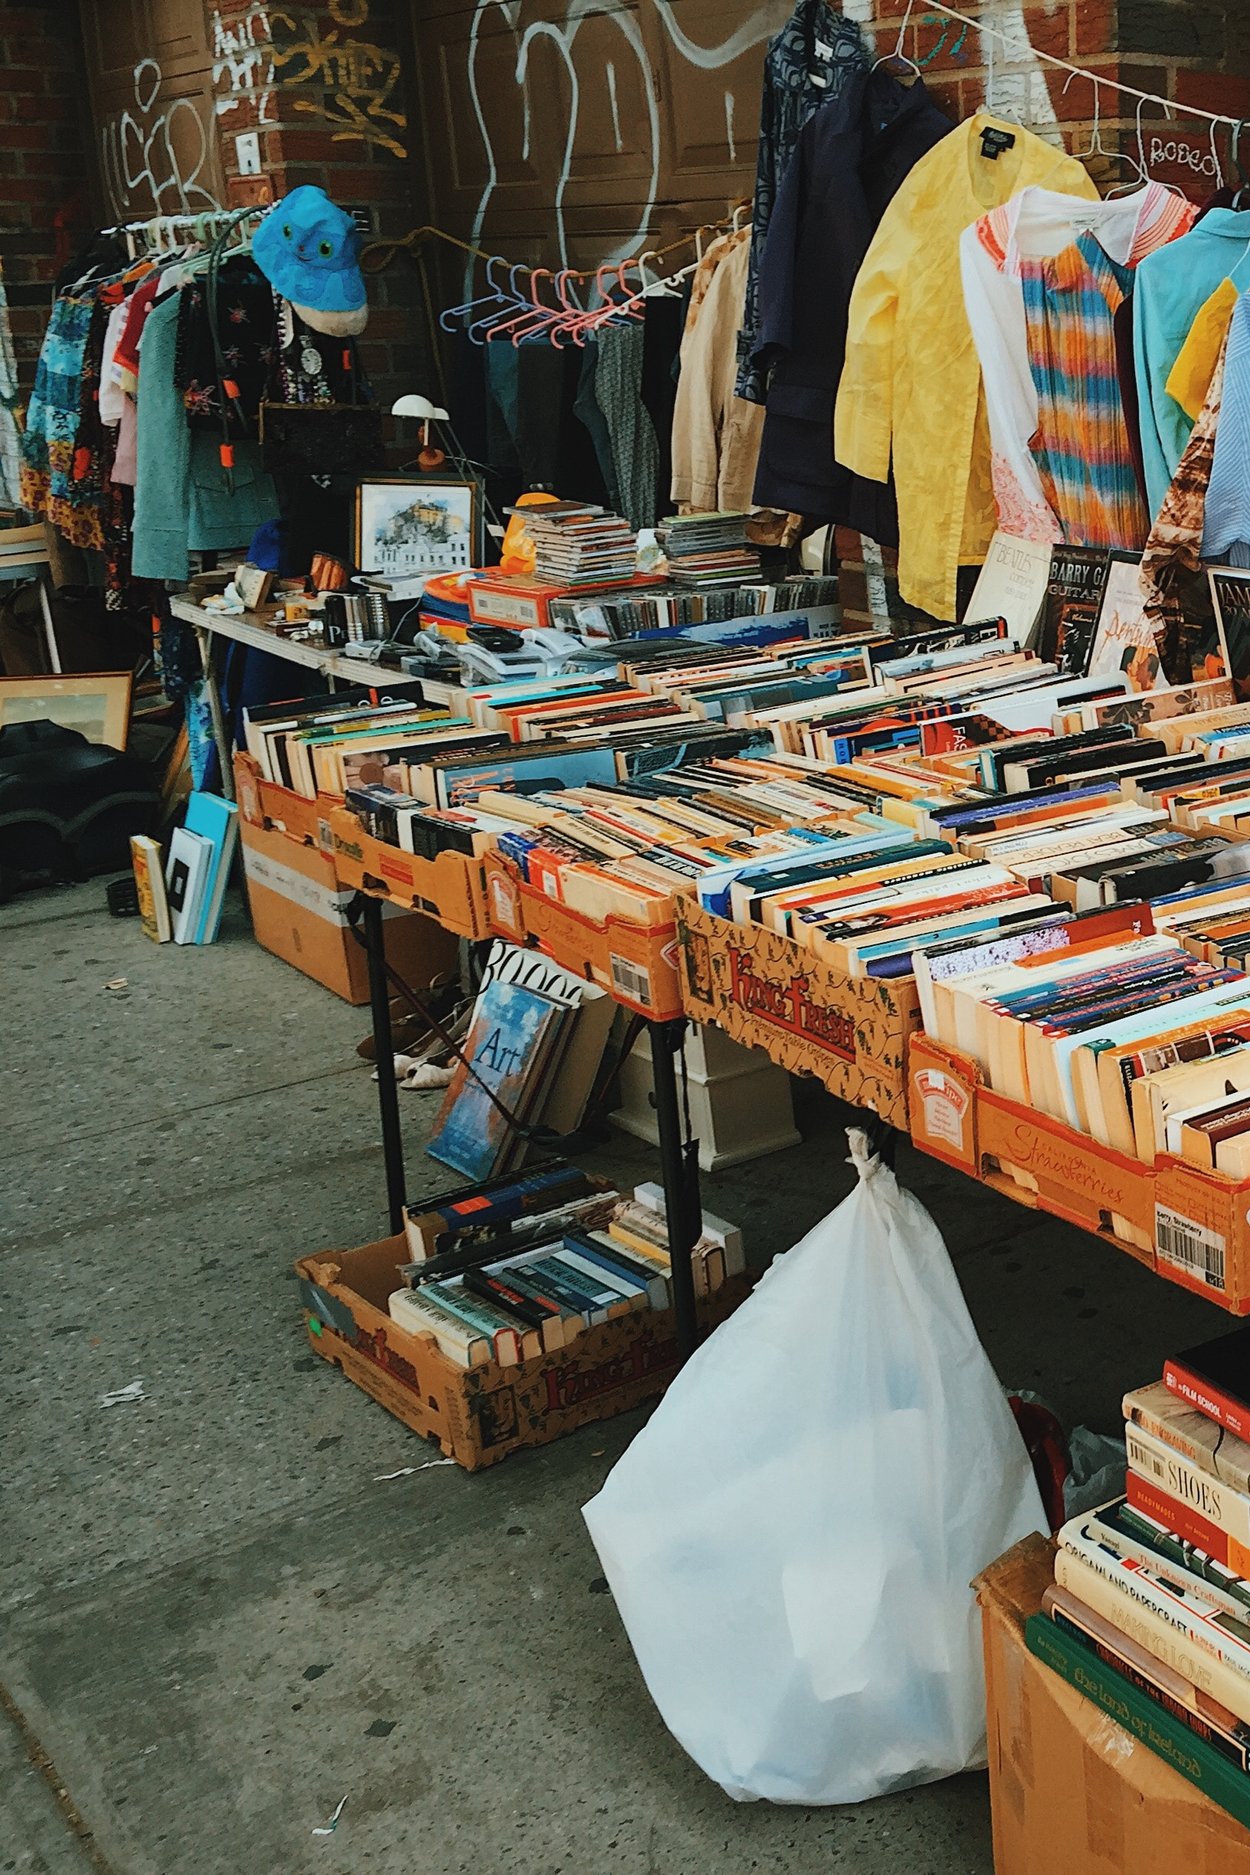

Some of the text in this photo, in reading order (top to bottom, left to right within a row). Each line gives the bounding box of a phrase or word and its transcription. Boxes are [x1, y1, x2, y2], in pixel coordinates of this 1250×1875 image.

[1050, 561, 1089, 584] BARRY
[1223, 605, 1237, 617] 20
[475, 1028, 521, 1077] Art
[1004, 1124, 1124, 1203] Strawberries
[1182, 1383, 1222, 1419] FILM SCHOOL
[1137, 1490, 1176, 1521] READYMADES
[1167, 1460, 1222, 1521] SHOES
[1065, 1541, 1107, 1578] ORIGAMI
[1107, 1572, 1129, 1595] AND
[1129, 1588, 1189, 1637] PAPERCRAFT
[1139, 1553, 1236, 1616] The Unknown Craftsman
[1111, 1601, 1171, 1663] MAKING
[1171, 1648, 1214, 1692] LOVE
